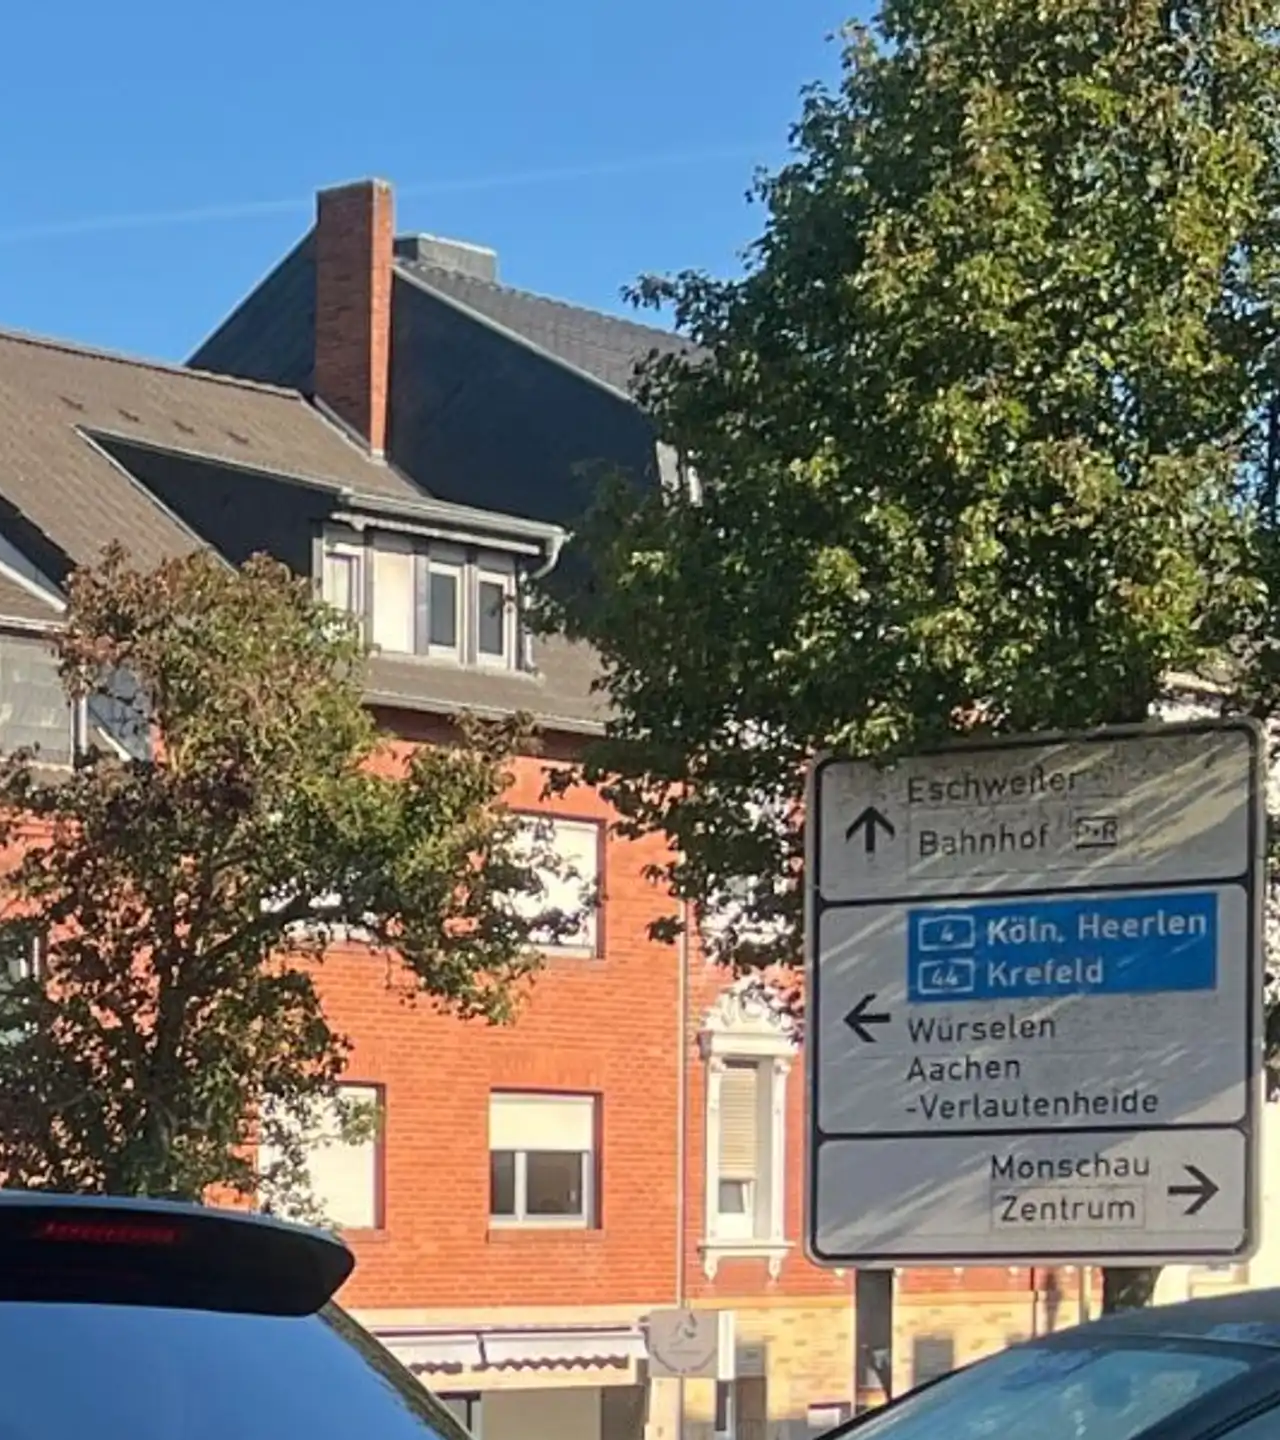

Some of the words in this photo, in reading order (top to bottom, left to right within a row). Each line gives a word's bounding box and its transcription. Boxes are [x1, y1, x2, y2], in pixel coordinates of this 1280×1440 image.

[907, 763, 1078, 802] Eschweiler
[919, 823, 1048, 856] Bahnhof
[1077, 909, 1207, 940] Heerlen
[931, 965, 959, 986] 44
[988, 957, 1103, 987] Krefeld
[907, 1013, 1056, 1043] Würselen
[906, 1055, 1020, 1082] Aachen
[905, 1088, 1159, 1119] -Verlautenheide
[991, 1152, 1150, 1181] Monschau
[1000, 1195, 1136, 1223] Zentrum
